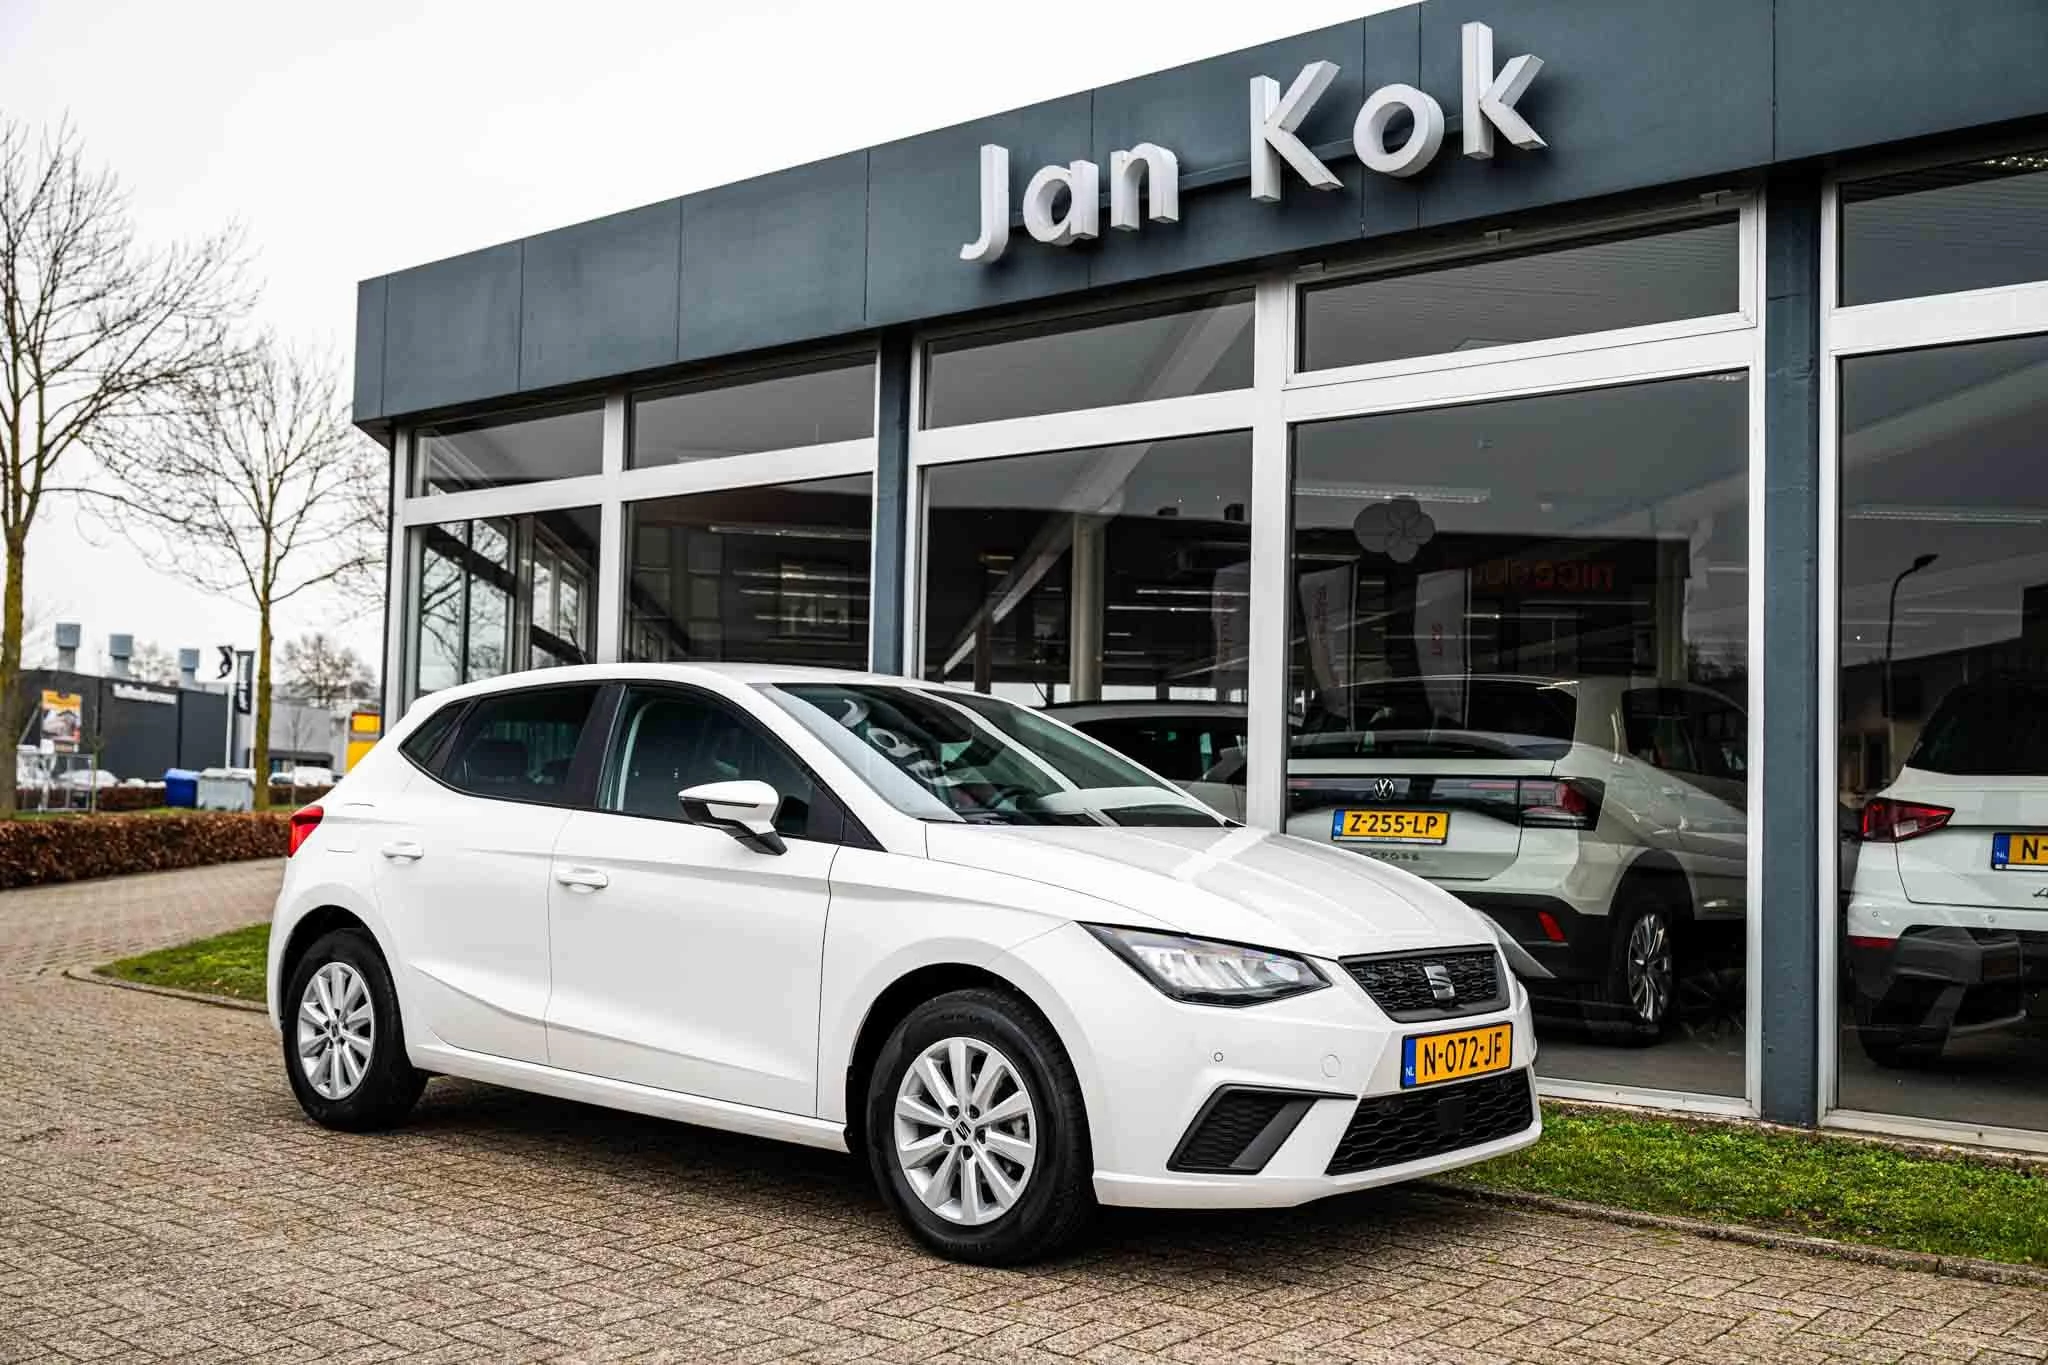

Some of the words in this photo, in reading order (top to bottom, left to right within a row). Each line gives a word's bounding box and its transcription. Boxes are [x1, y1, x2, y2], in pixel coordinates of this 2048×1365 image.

[960, 143, 1179, 264] Jan
[1250, 21, 1548, 200] Kok
[1350, 814, 1438, 834] Z-255-LP
[1424, 1032, 1502, 1077] N-072-JF
[1405, 1066, 1415, 1077] NL
